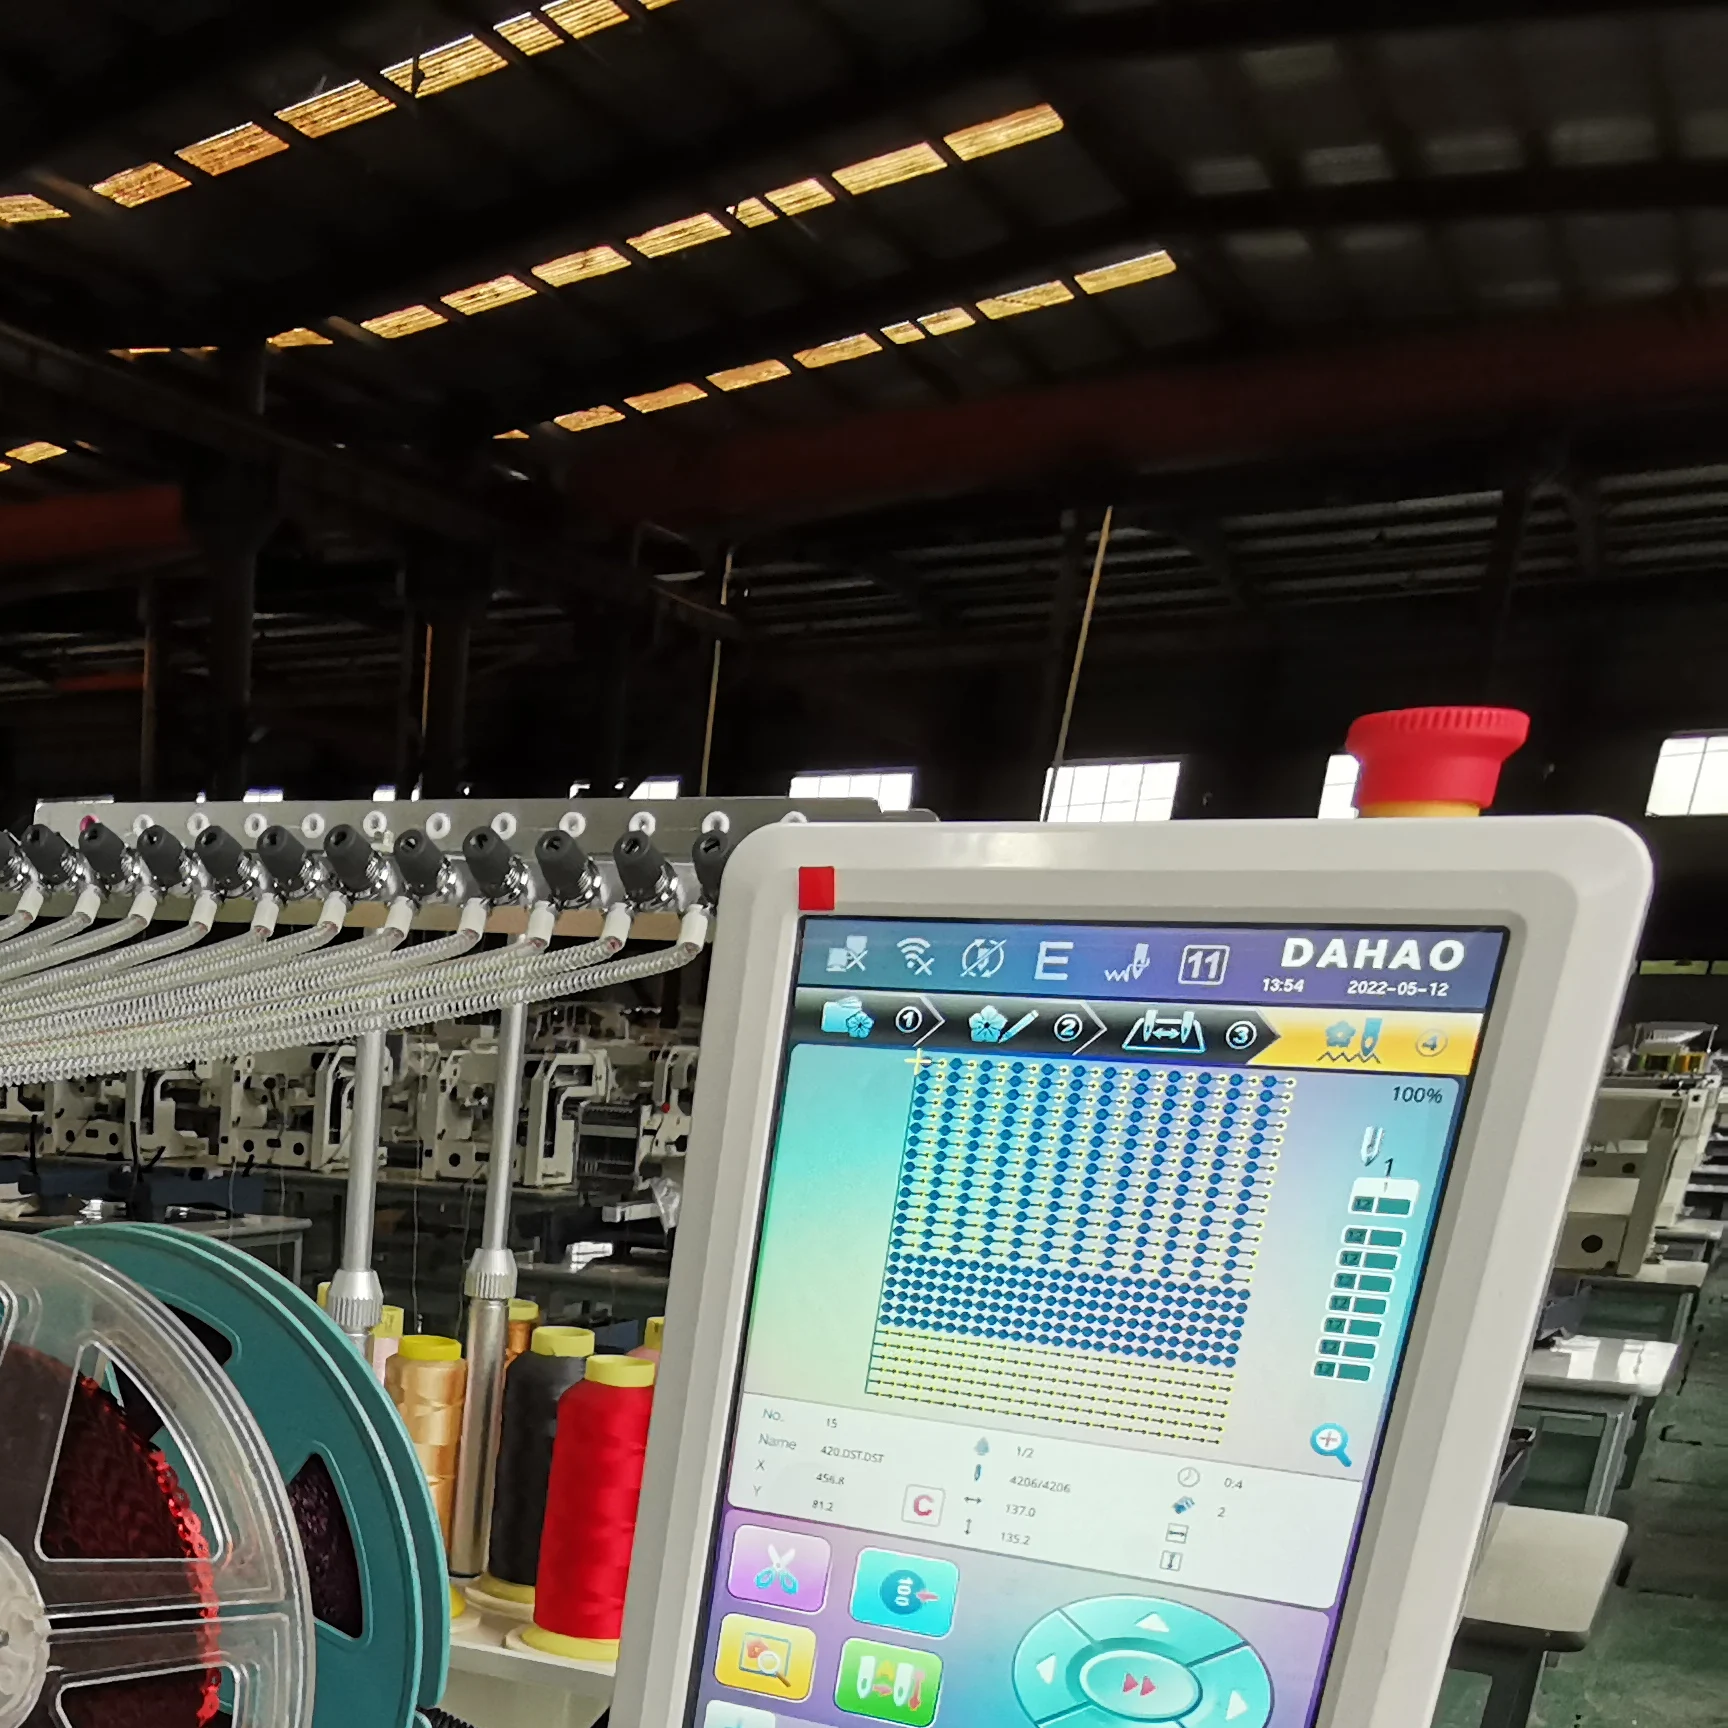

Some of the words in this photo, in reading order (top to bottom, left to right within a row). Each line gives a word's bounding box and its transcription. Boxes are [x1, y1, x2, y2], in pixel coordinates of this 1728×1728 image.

[1034, 940, 1074, 981] E
[1281, 937, 1466, 972] DAHAO
[1185, 950, 1224, 980] 11
[1262, 977, 1305, 994] 13:54
[1347, 980, 1449, 997] 2022-05-12
[1392, 1085, 1443, 1104] 100%
[1384, 1157, 1394, 1178] 1
[761, 1408, 785, 1422] No.
[826, 1418, 838, 1429] 15
[758, 1433, 797, 1450] Name
[820, 1446, 885, 1464] 420.DST.DST
[1016, 1446, 1035, 1459] 1/2
[755, 1459, 765, 1471] X
[752, 1485, 762, 1497] Y
[1009, 1476, 1071, 1494] 4206/4206
[1005, 1503, 1037, 1518] 137.0
[1216, 1506, 1226, 1518] 2
[1001, 1531, 1031, 1545] 135.2
[894, 1576, 914, 1607] 100
